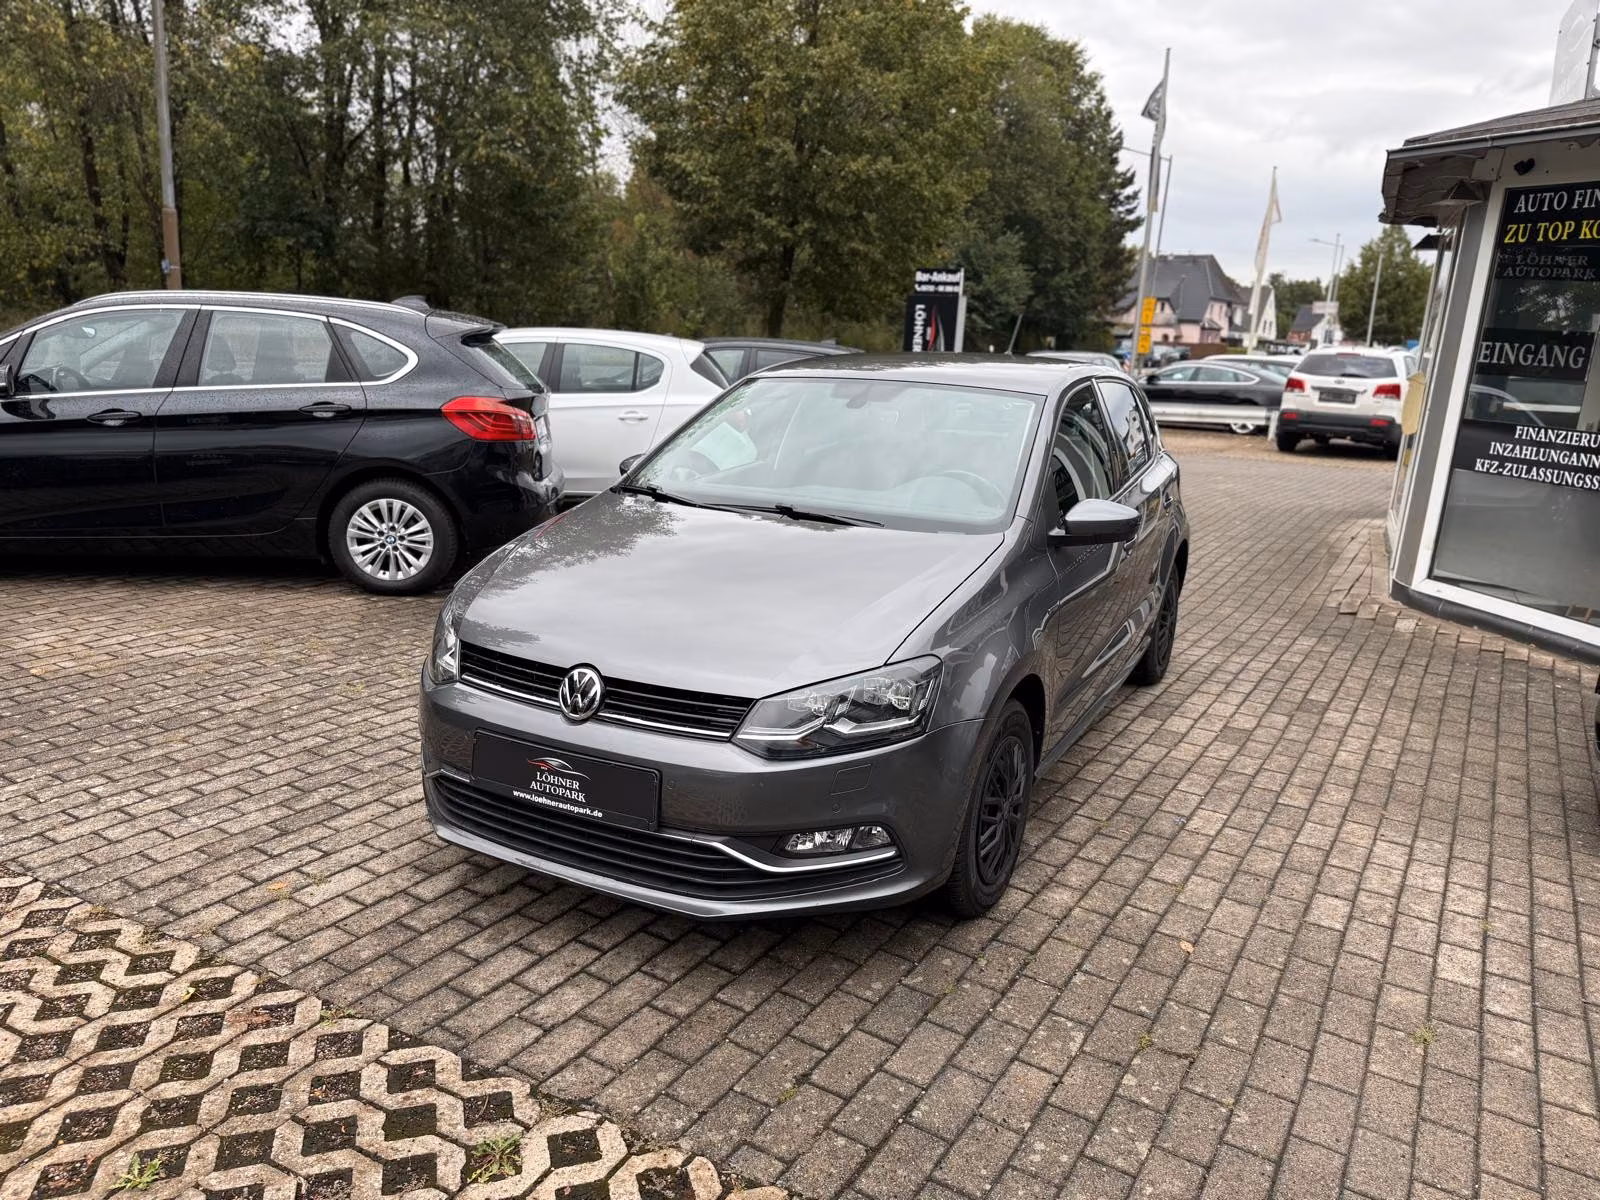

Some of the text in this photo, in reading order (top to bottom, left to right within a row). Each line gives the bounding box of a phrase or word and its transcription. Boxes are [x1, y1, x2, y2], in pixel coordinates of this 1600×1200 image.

[1513, 191, 1568, 213] AUTO
[1504, 224, 1532, 243] ZU
[1536, 220, 1575, 242] TOP
[1503, 266, 1597, 280] AUTOPARK
[1478, 341, 1586, 369] EINGANG
[1514, 425, 1600, 448] FINANZIERU
[1489, 441, 1600, 470] INZAHLUNGANN
[1474, 458, 1600, 491] KFZ-ZULASSUNGSS
[529, 780, 587, 803] AUTOPARK
[536, 771, 580, 790] LÖHNER
[512, 789, 603, 818] www.loehnerautopark.de
